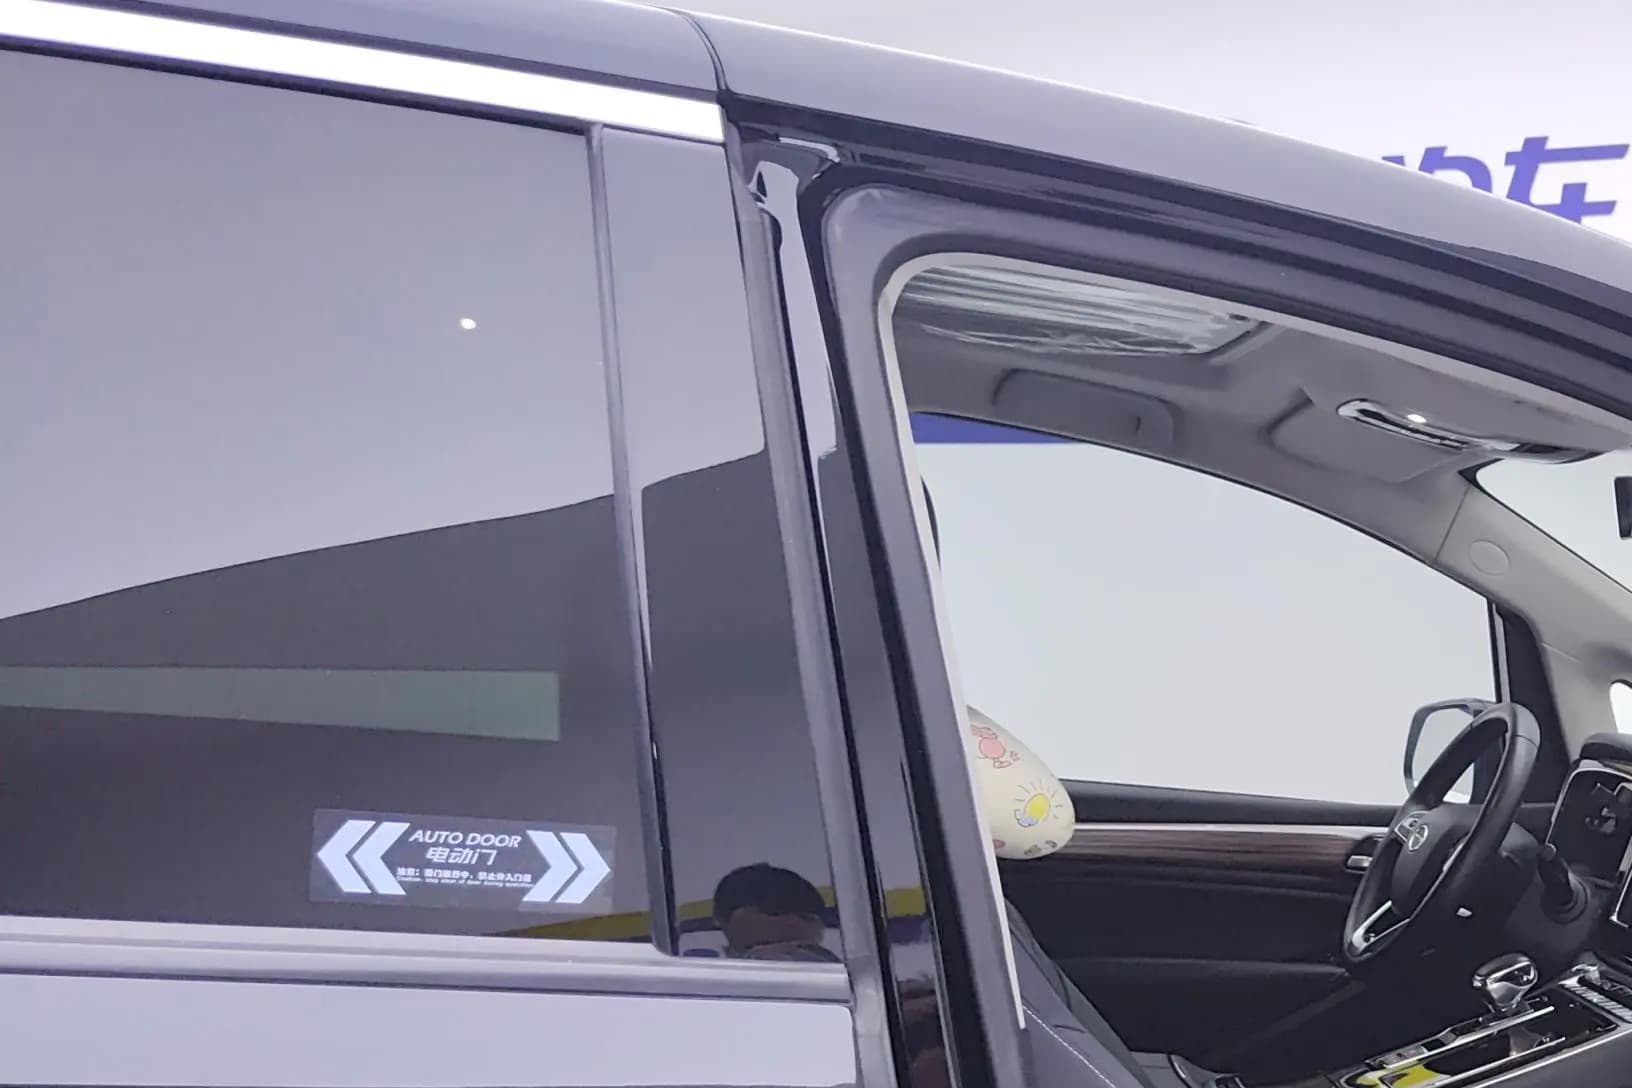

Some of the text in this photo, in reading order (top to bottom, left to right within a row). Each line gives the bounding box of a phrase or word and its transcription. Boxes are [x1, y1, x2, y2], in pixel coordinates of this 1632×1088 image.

[408, 830, 522, 848] AUTO DOOR
[426, 847, 497, 865] 电动门
